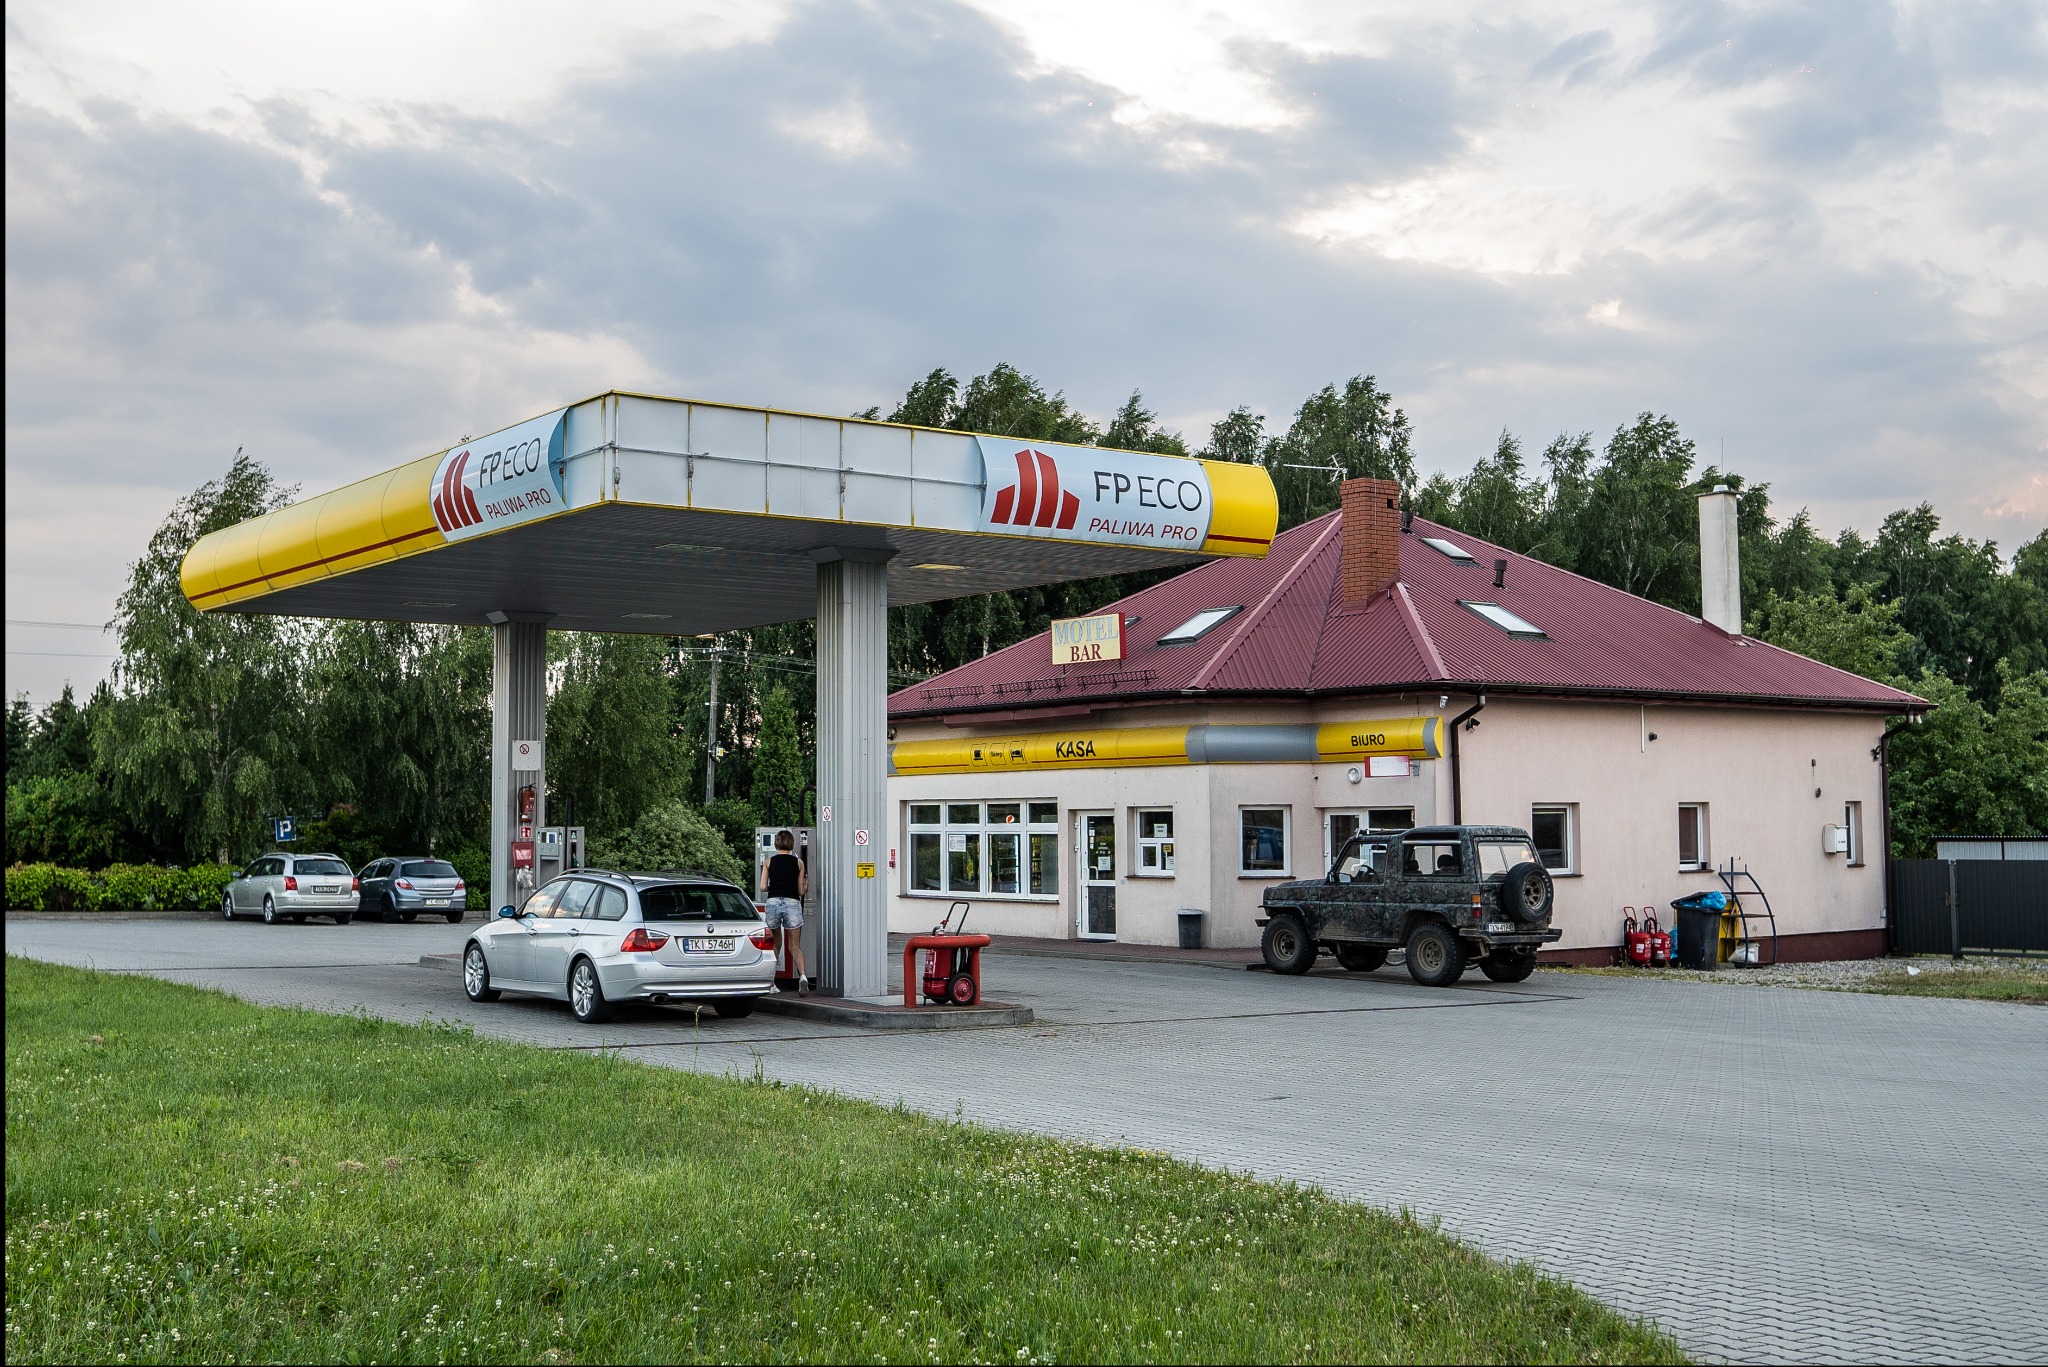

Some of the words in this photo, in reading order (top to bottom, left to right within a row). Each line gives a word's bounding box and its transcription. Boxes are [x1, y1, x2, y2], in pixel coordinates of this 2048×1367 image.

[485, 496, 528, 519] PALIWA
[525, 488, 551, 509] PRO
[1088, 518, 1154, 537] PALIWA
[1160, 524, 1198, 540] PRO
[1053, 616, 1118, 646] MOTEL
[1070, 643, 1102, 662] BAR
[1055, 740, 1096, 758] KASA
[1351, 733, 1386, 747] BIURO
[707, 939, 734, 950] 5746H
